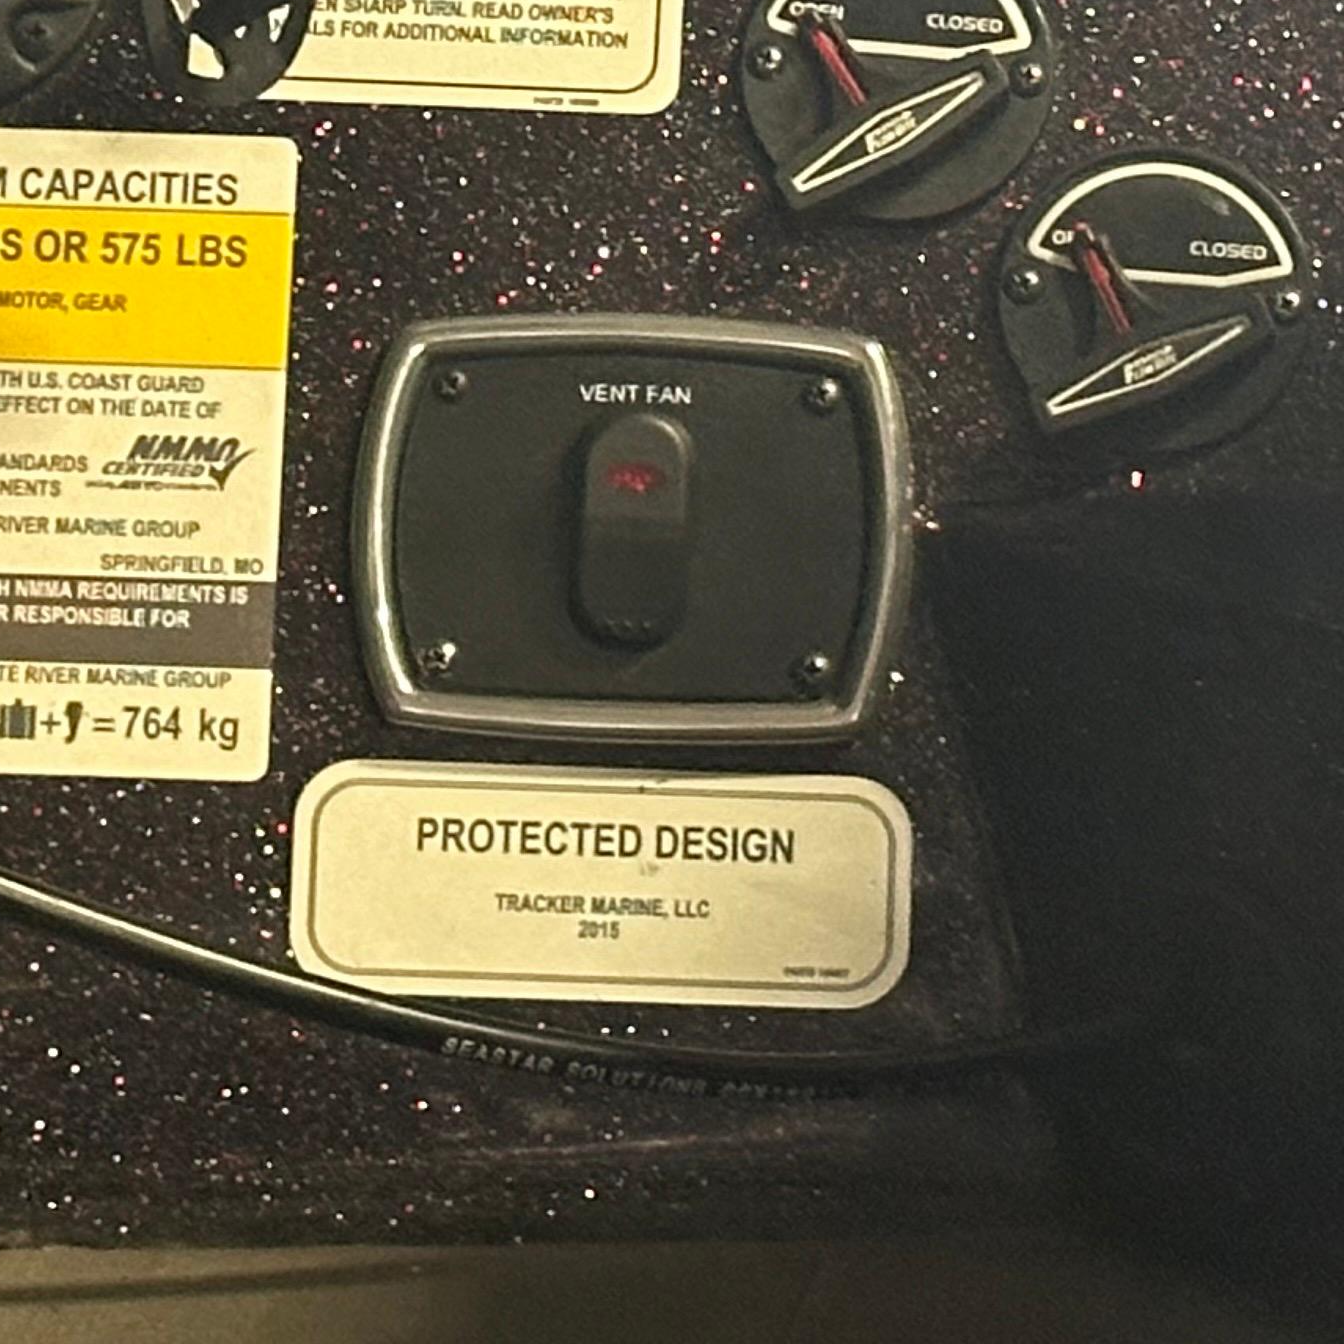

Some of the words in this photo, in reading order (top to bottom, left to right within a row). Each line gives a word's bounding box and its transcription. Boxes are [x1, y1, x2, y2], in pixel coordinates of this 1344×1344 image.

[471, 0, 523, 20] READ
[527, 3, 614, 24] OWNER'S
[926, 13, 1004, 33] CLOSED
[340, 19, 378, 38] FOR
[382, 21, 495, 43] ADDITIONAL
[499, 26, 628, 48] INFORMATION
[19, 167, 238, 207] CAPACITIES
[33, 228, 87, 263] OR
[100, 231, 160, 265] 575
[176, 233, 247, 268] LBS
[1189, 240, 1267, 261] CLOSED
[72, 292, 127, 312] GEAR
[27, 370, 62, 389] U.S.
[67, 371, 132, 391] COAST
[136, 374, 204, 393] GUARD
[579, 383, 639, 402] VENT
[646, 384, 691, 403] FAN
[65, 396, 94, 415] ON
[99, 397, 136, 416] THE
[140, 399, 190, 419] DATE
[195, 400, 221, 419] OF
[54, 517, 127, 536] MARINE
[131, 518, 200, 538] GROUP
[233, 557, 264, 575] MO
[14, 578, 72, 599] NMMA
[76, 580, 225, 604] REQUIREMENTS
[229, 585, 248, 604] IS
[12, 604, 145, 627] RESPONSIBLE
[149, 607, 189, 628] FOR
[24, 662, 80, 684] RIVER
[86, 667, 160, 687] MARINE
[164, 669, 233, 689] GROUP
[198, 707, 239, 751] kg
[417, 817, 642, 857] PROTECTED
[655, 824, 794, 864] DESIGN
[494, 892, 585, 914] TRACKER
[590, 896, 669, 920] MARINE,
[673, 898, 710, 919] LLC
[577, 919, 619, 939] 2015
